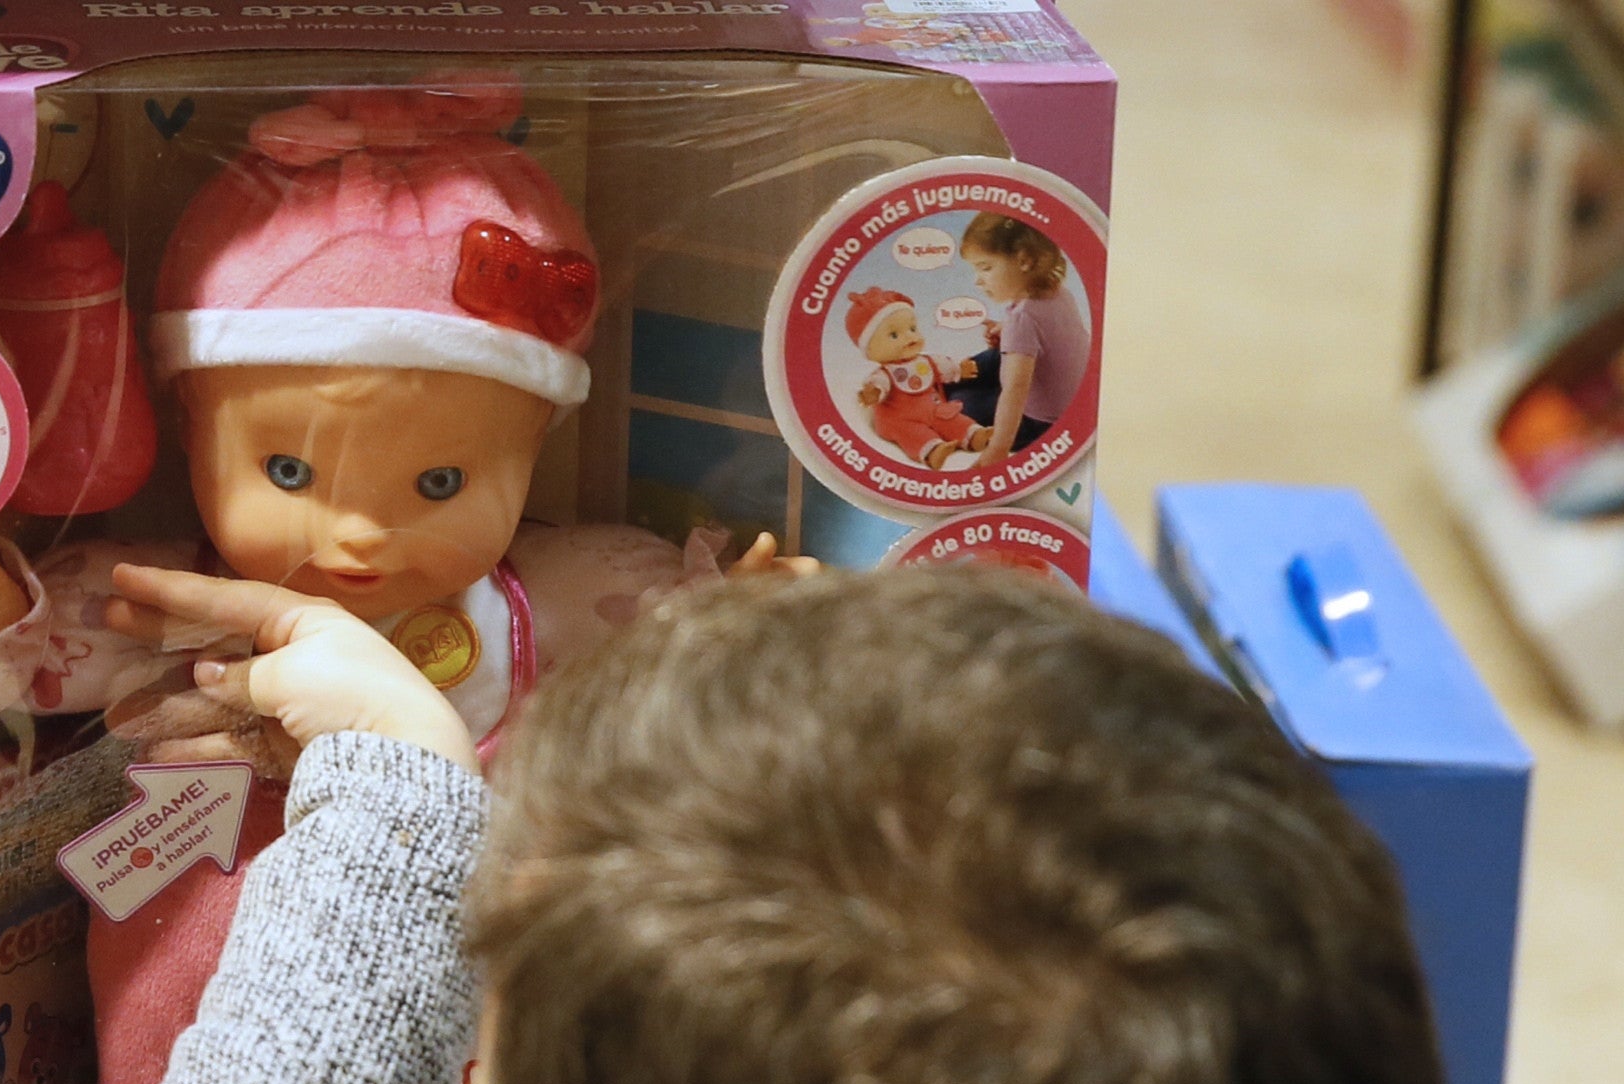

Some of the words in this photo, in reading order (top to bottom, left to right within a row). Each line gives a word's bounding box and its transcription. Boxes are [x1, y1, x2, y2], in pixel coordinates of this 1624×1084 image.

[86, 3, 220, 17] Rita
[240, 1, 503, 19] aprende
[529, 4, 569, 15] a
[584, 1, 789, 16] hablar
[802, 237, 861, 315] Cuanto
[861, 202, 910, 239] más
[913, 184, 1051, 225] juguemos...
[898, 244, 911, 255] Te
[913, 244, 950, 257] quiero
[940, 308, 951, 317] Te
[953, 307, 984, 319] quiero
[817, 424, 869, 472] antes
[870, 466, 985, 501] aprenderé
[990, 475, 1007, 492] a
[1006, 430, 1074, 485] hablar
[931, 537, 959, 559] de
[963, 524, 993, 545] 80
[999, 522, 1064, 553] frases
[91, 779, 209, 870] ¡PRUÉBAME!
[96, 864, 133, 893] Pulsa
[151, 843, 161, 856] y
[156, 861, 166, 871] a
[167, 825, 213, 864] hablar!
